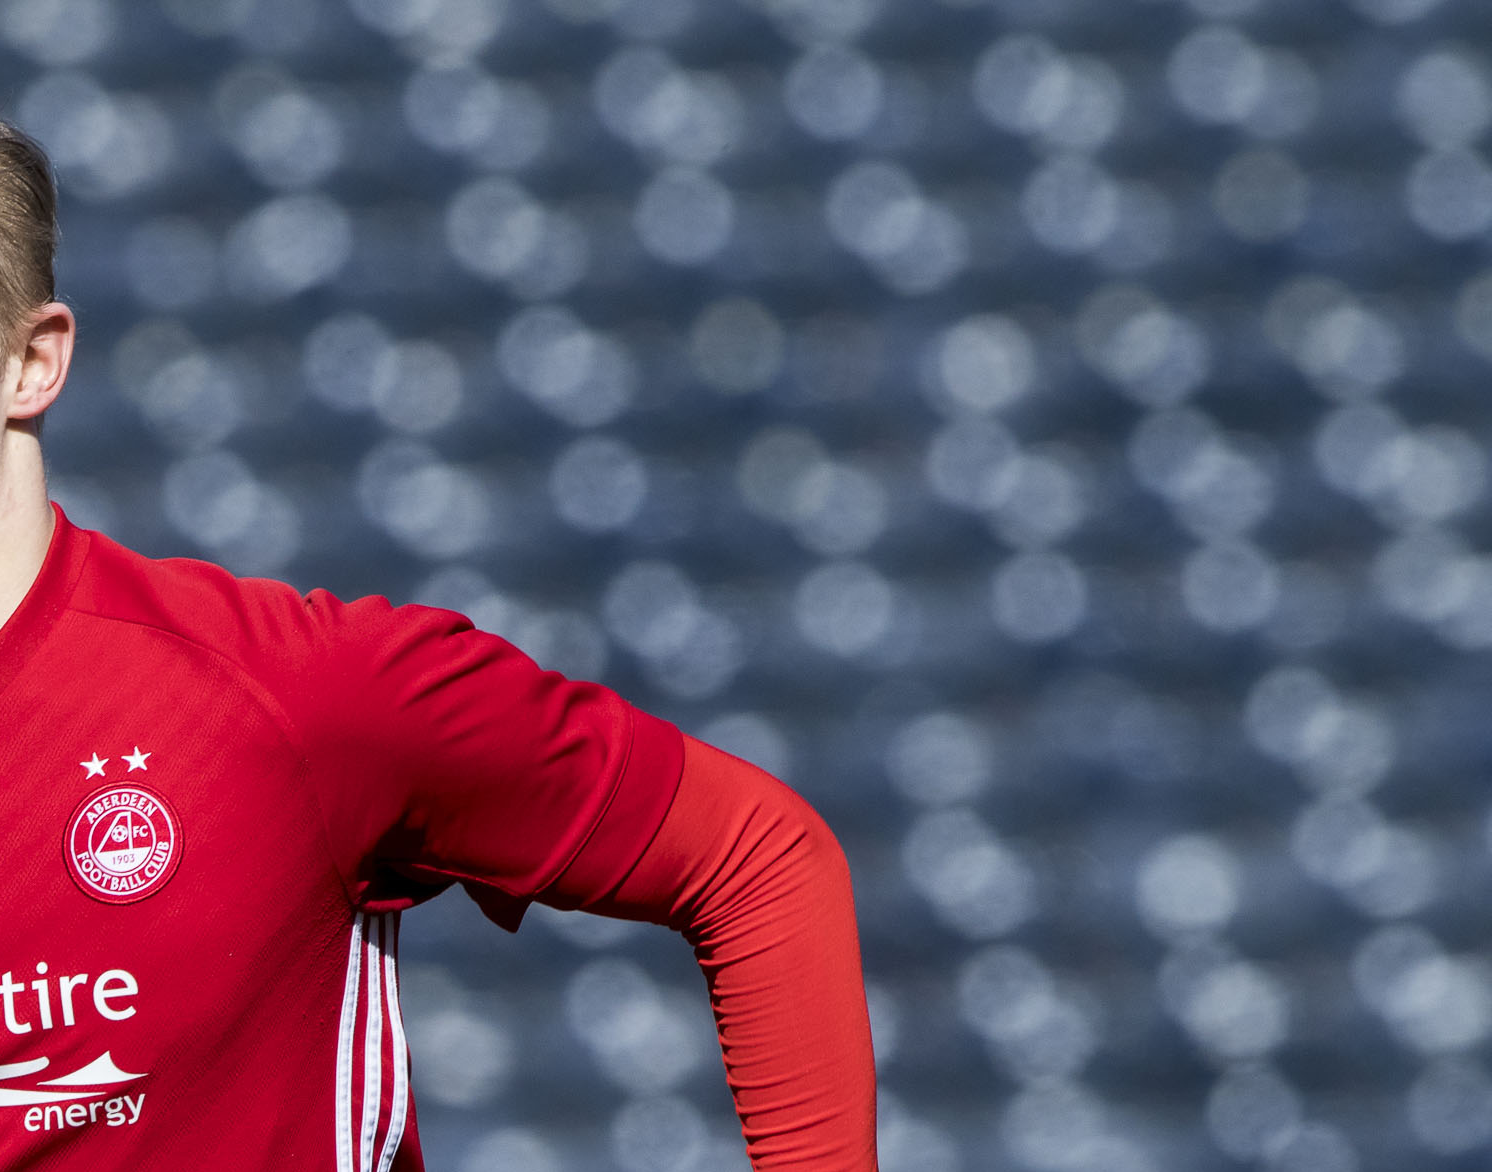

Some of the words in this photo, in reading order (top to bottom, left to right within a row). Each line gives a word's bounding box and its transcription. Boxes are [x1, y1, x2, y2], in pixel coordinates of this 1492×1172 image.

[86, 793, 157, 824] ABERDEEN
[77, 851, 146, 891] FOOTBALL
[144, 841, 170, 878] CLUB
[112, 854, 135, 865] 1903
[24, 1092, 146, 1132] energy
